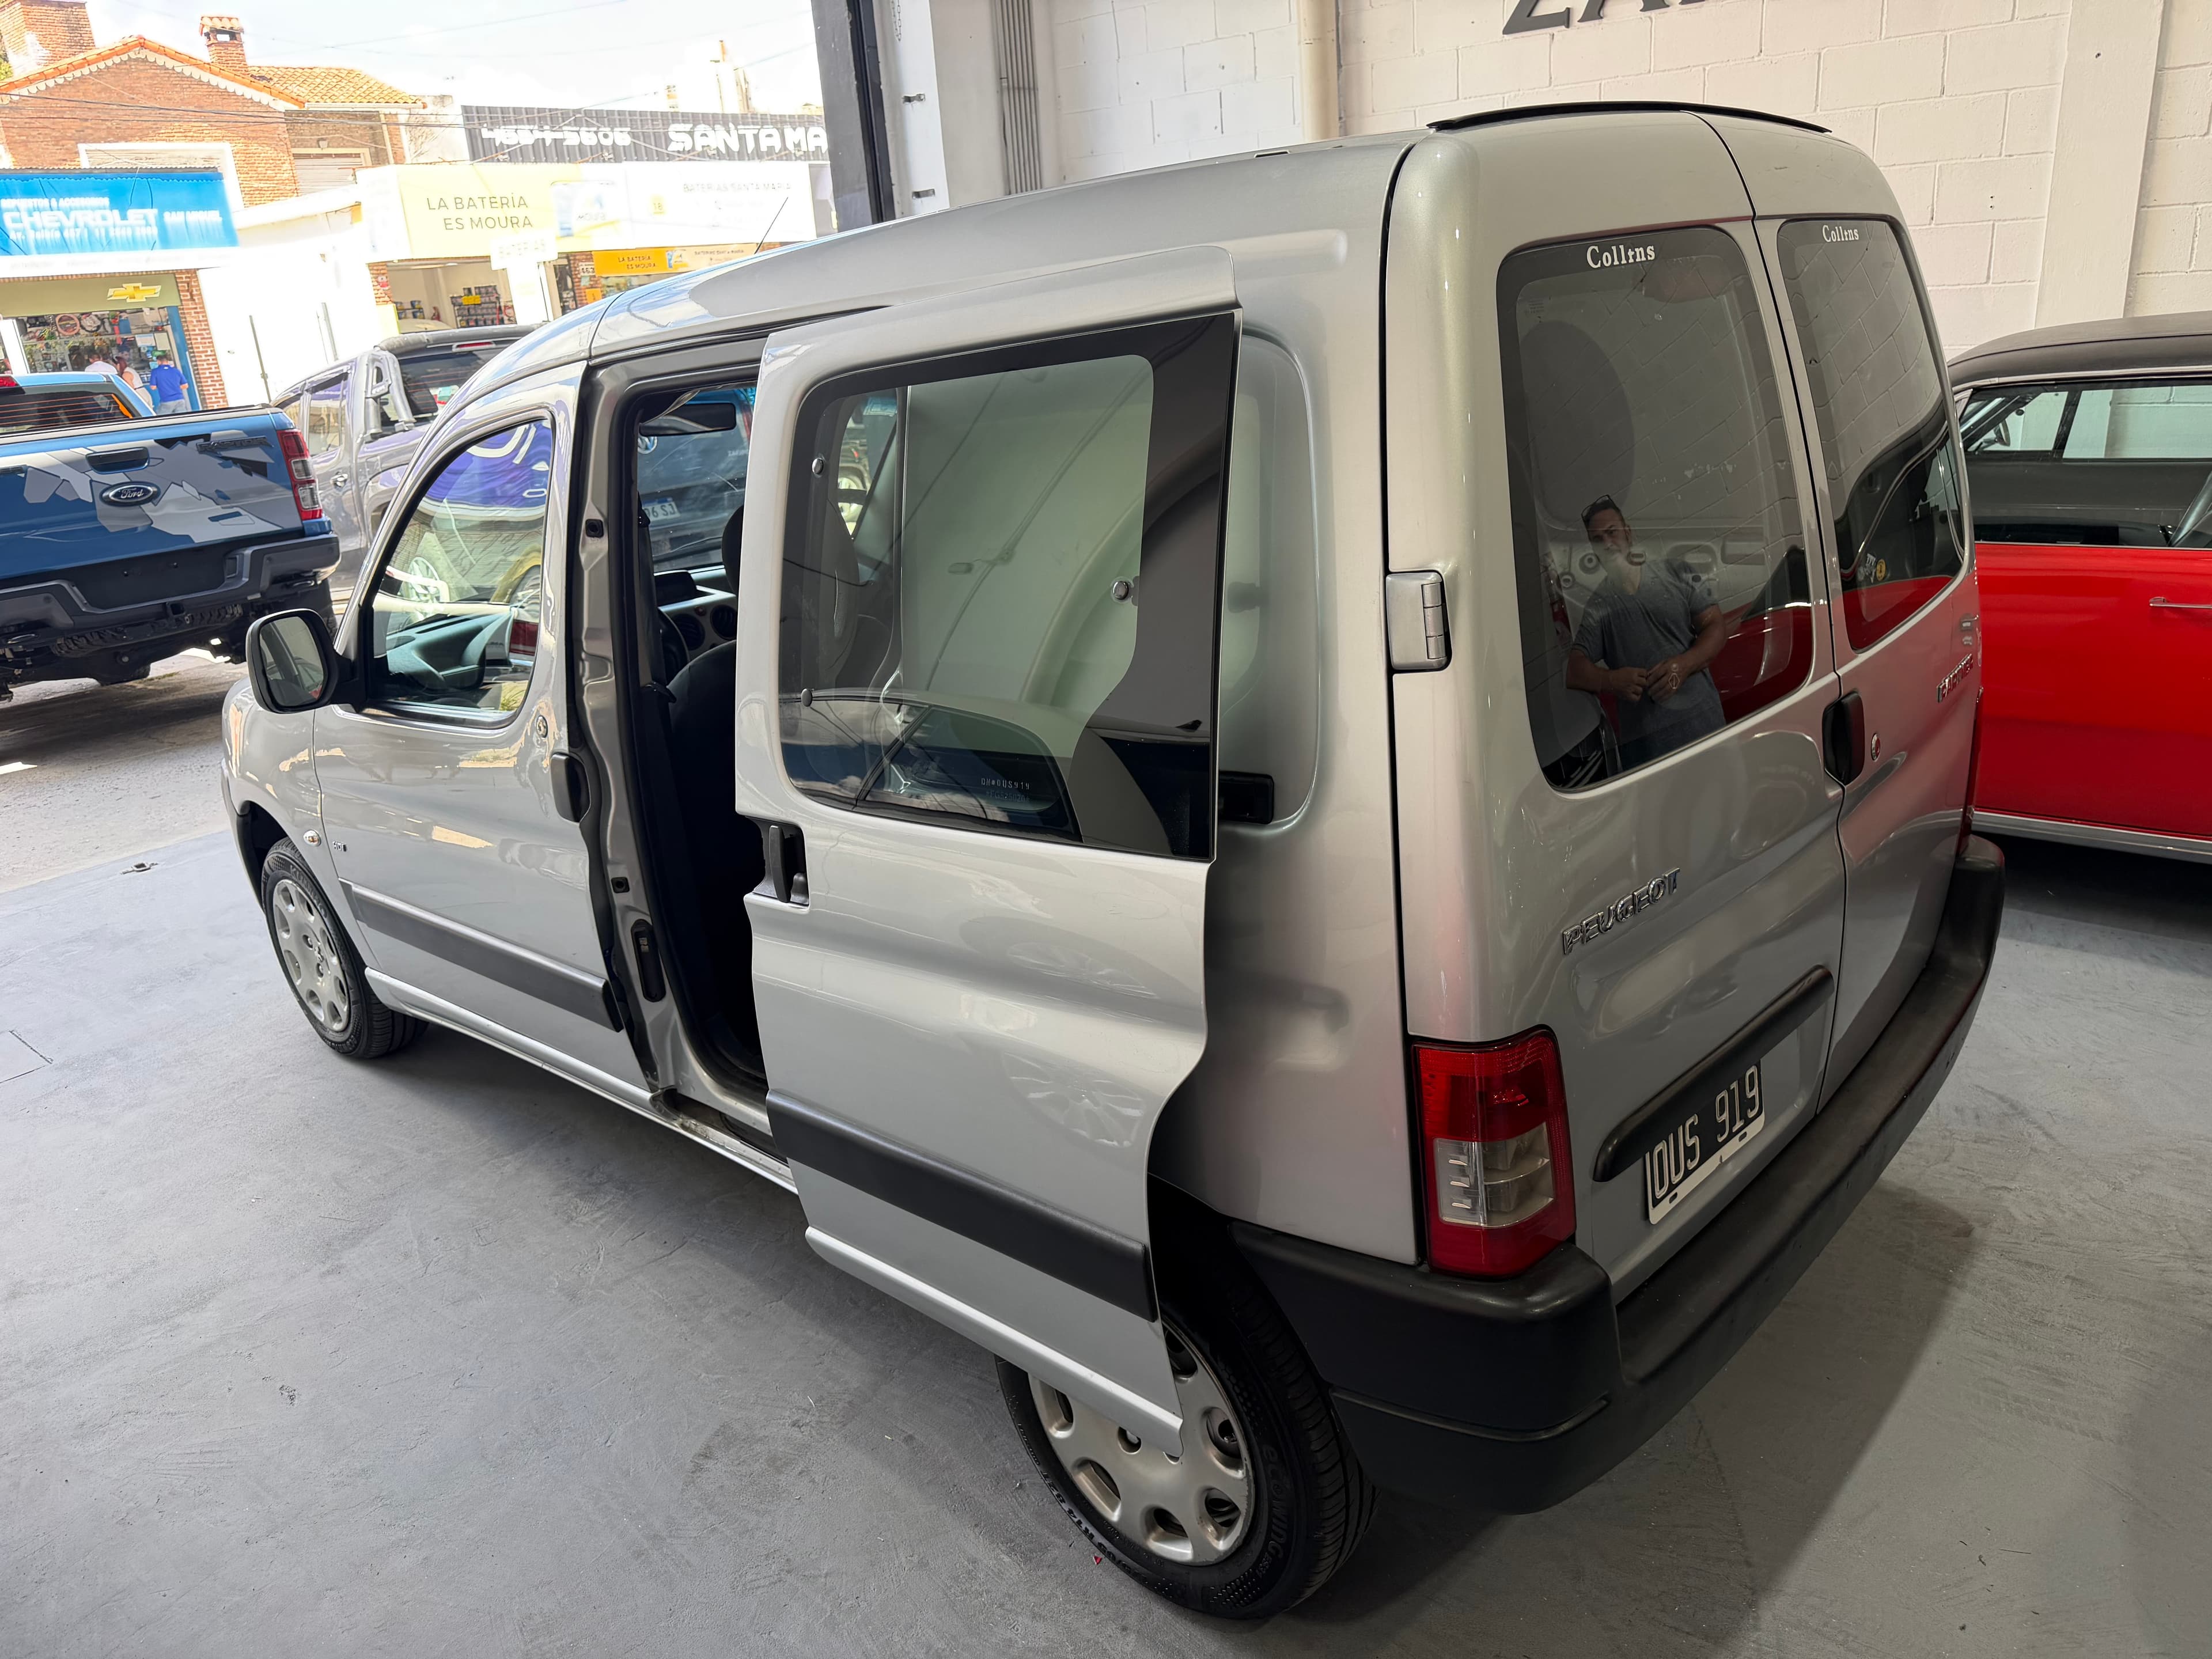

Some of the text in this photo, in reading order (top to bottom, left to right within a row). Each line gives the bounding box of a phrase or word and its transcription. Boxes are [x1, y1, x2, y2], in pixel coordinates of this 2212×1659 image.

[667, 122, 782, 154] SANTA
[427, 192, 528, 210] LA BATERÍA
[3, 209, 158, 228] CHEVROLET
[444, 216, 533, 230] ES MOURA
[1822, 225, 1859, 243] Collins
[1586, 244, 1656, 269] Collins
[121, 488, 143, 499] Ford
[1562, 868, 1680, 955] PEUGEOT
[1653, 1065, 1760, 1199] OUS 919
